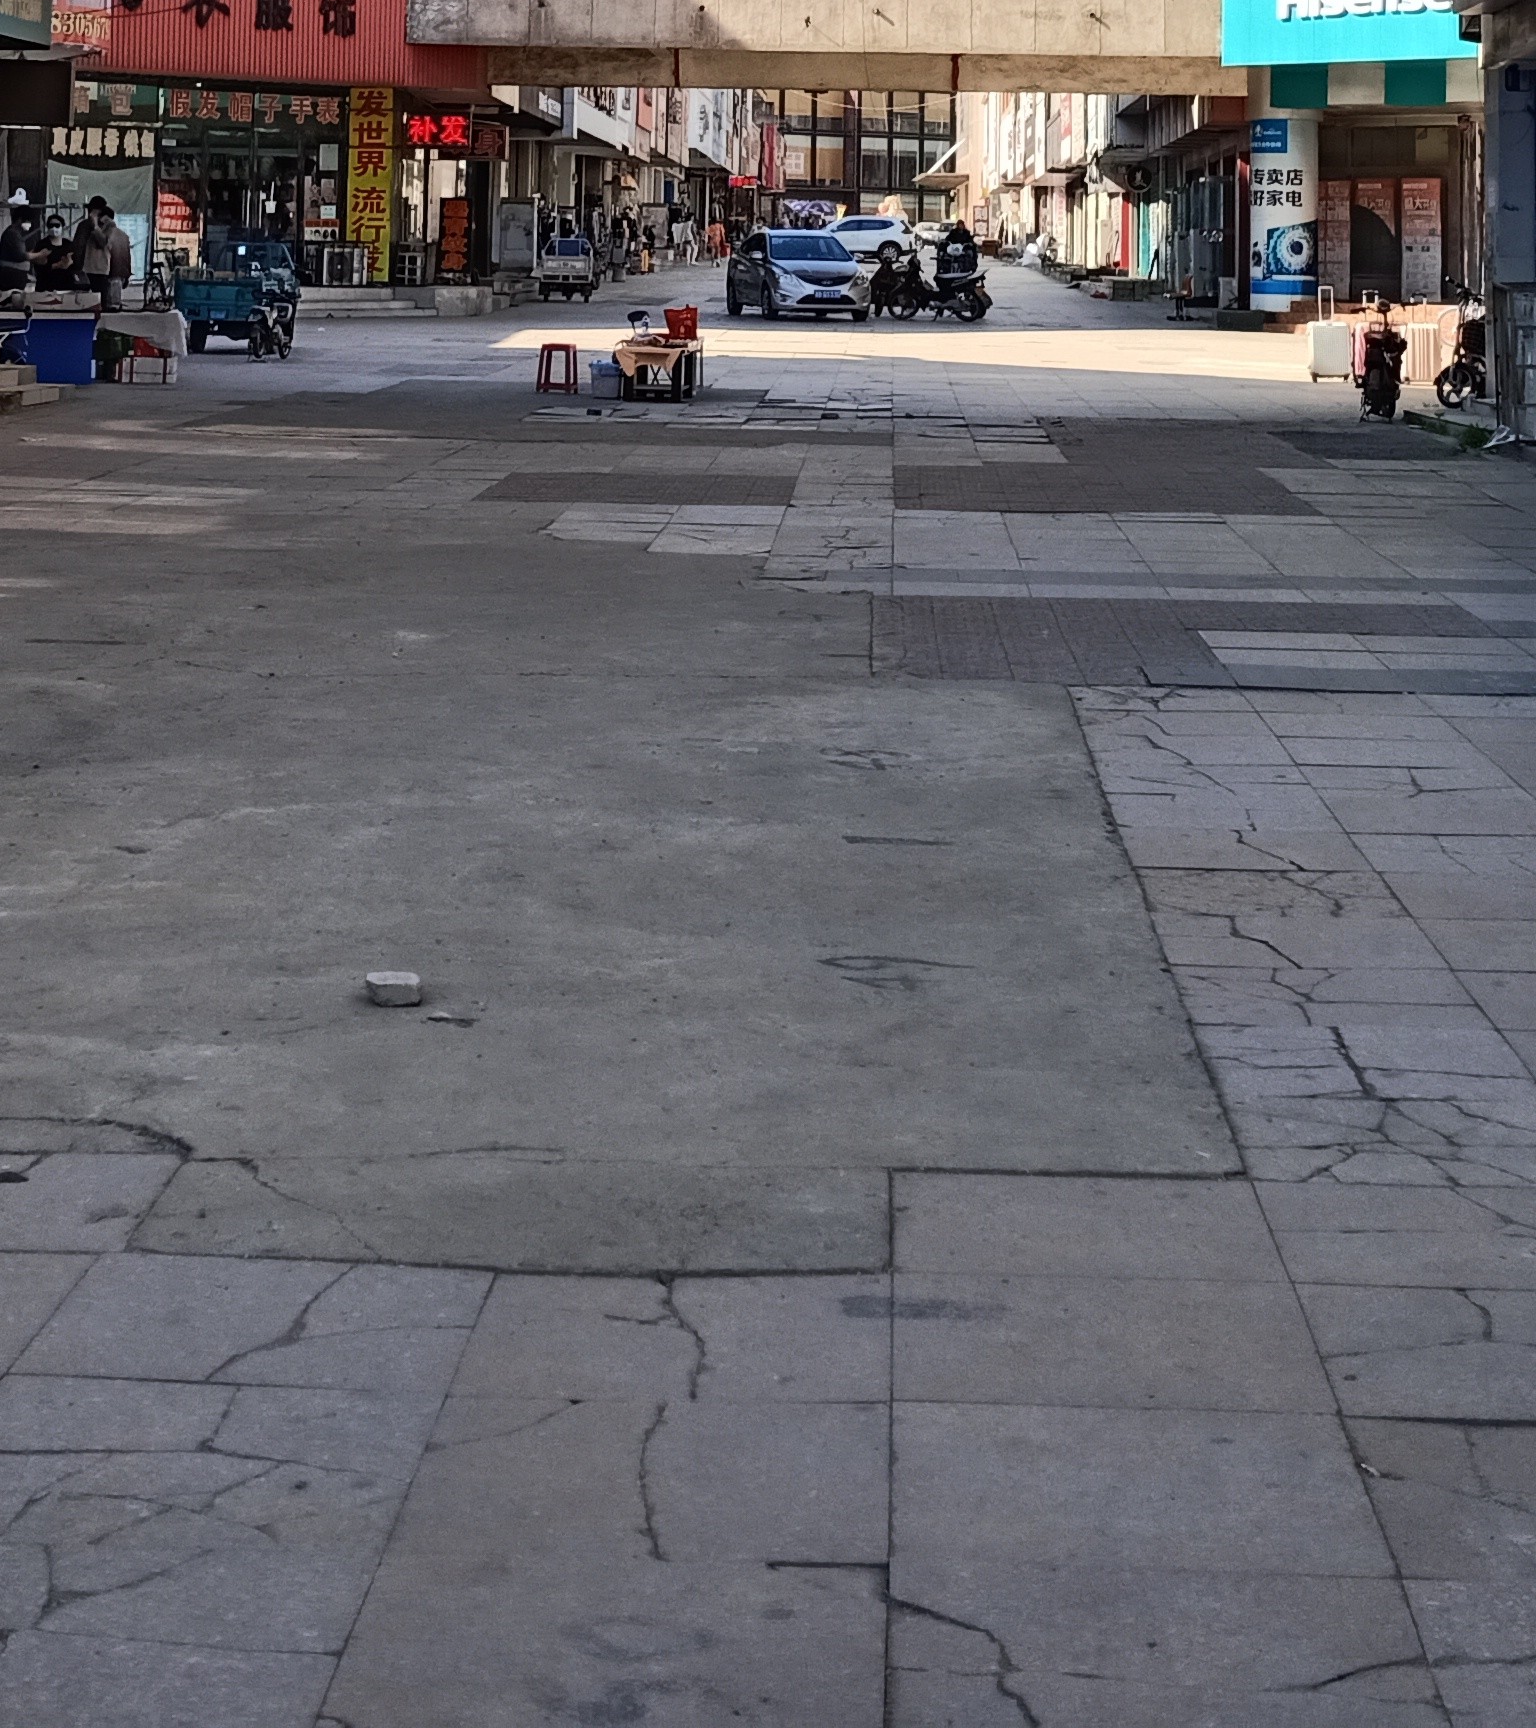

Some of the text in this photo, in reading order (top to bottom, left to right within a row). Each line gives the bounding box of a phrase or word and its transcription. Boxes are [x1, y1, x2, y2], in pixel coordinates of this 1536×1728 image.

[169, 89, 341, 124] 假发帽子手表
[352, 90, 389, 177] 发世界
[408, 115, 469, 144] 补发
